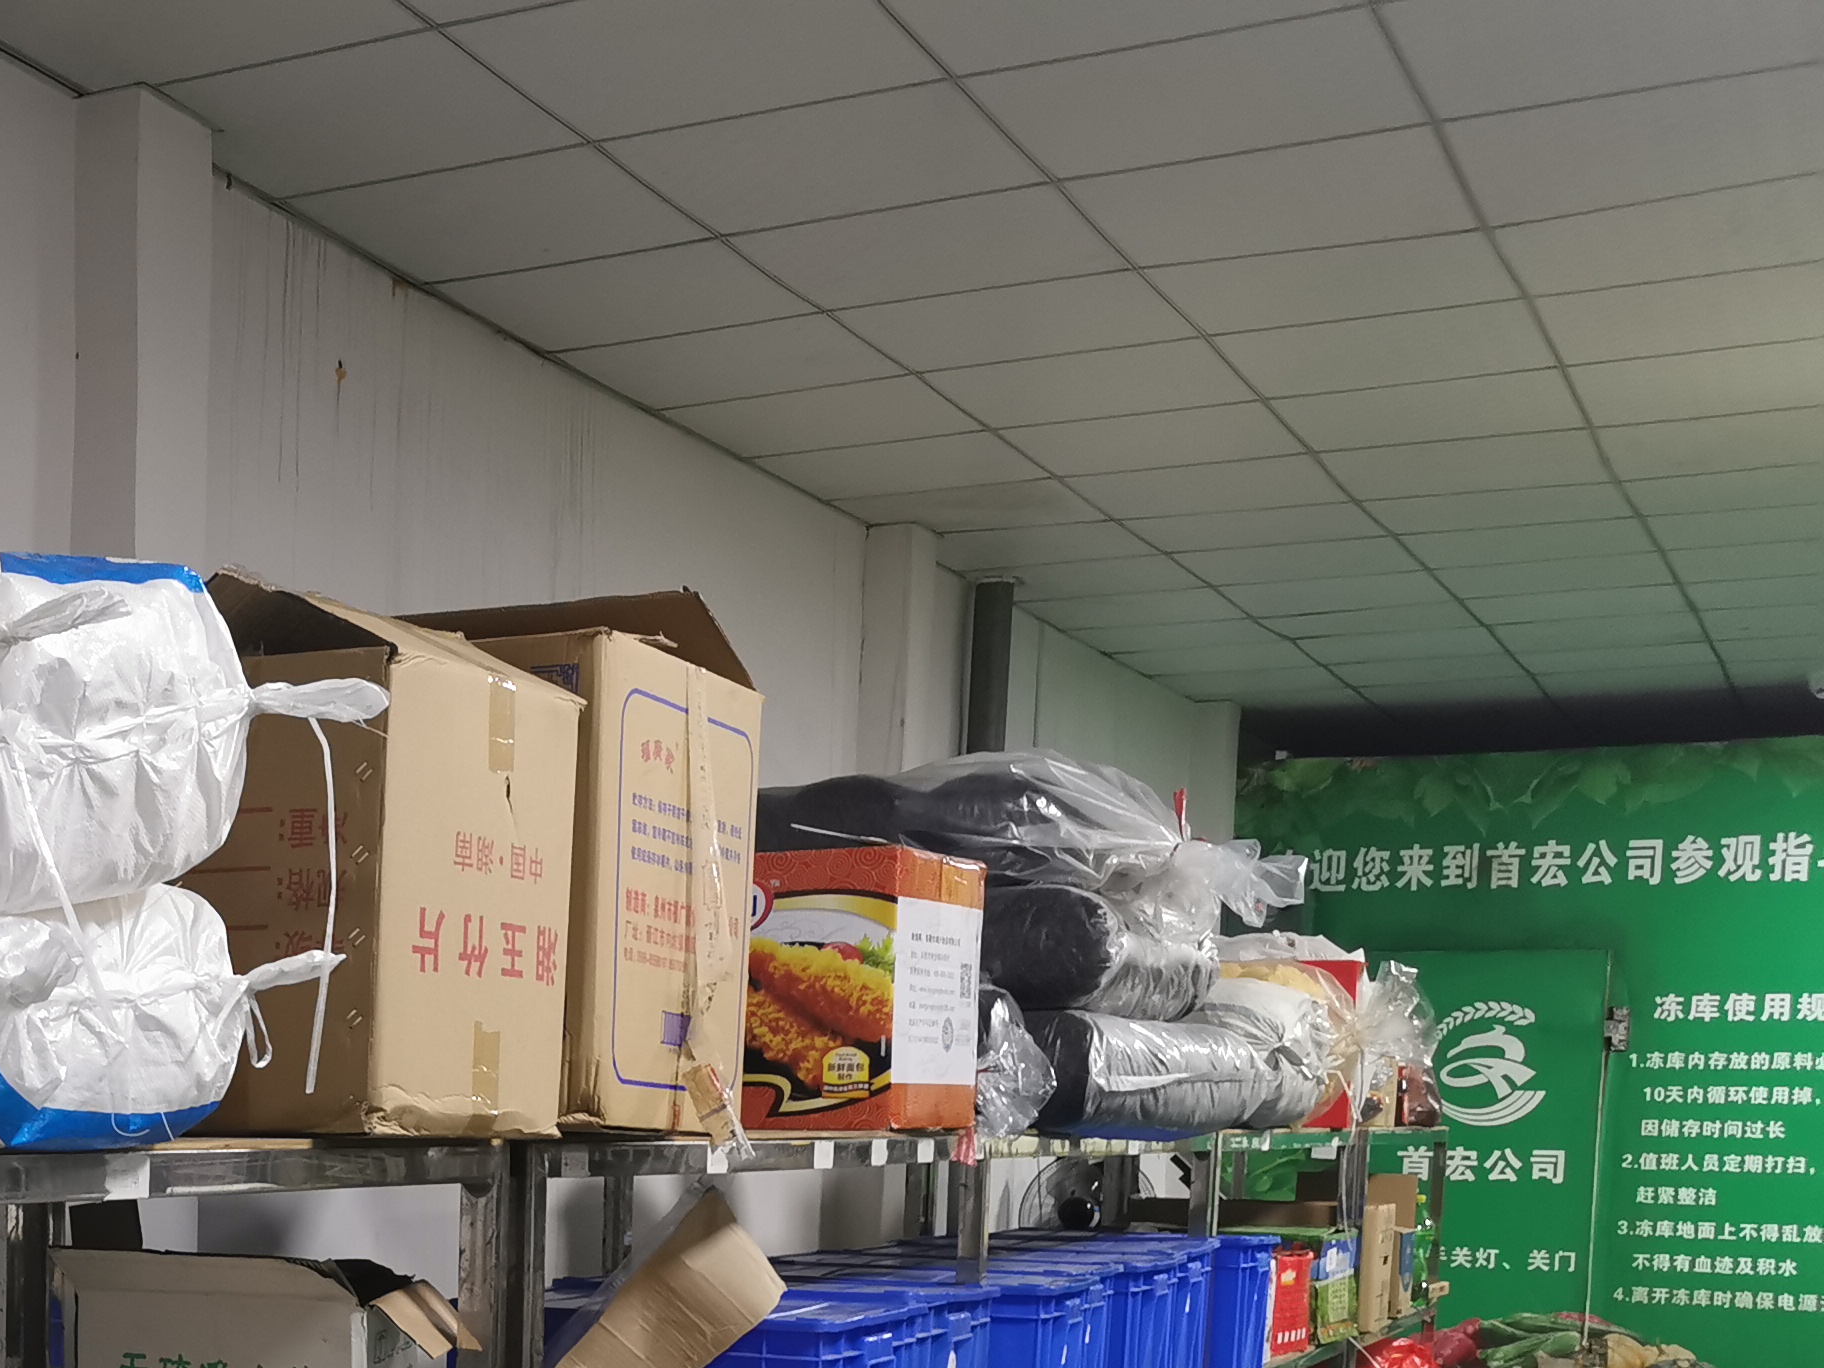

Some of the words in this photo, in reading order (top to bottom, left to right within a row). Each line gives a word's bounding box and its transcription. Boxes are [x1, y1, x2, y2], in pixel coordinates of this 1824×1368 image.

[1271, 833, 1824, 891] 迎您来到首宏公司参观指
[1640, 1119, 1786, 1139] 因储存时间过长
[1397, 1146, 1566, 1184] 首宏公司
[1635, 1186, 1718, 1206] 赶紧整洁
[1631, 1254, 1798, 1277] 不得有血迹及积水
[1613, 1286, 1824, 1313] 4.离开冻库时确保电源
